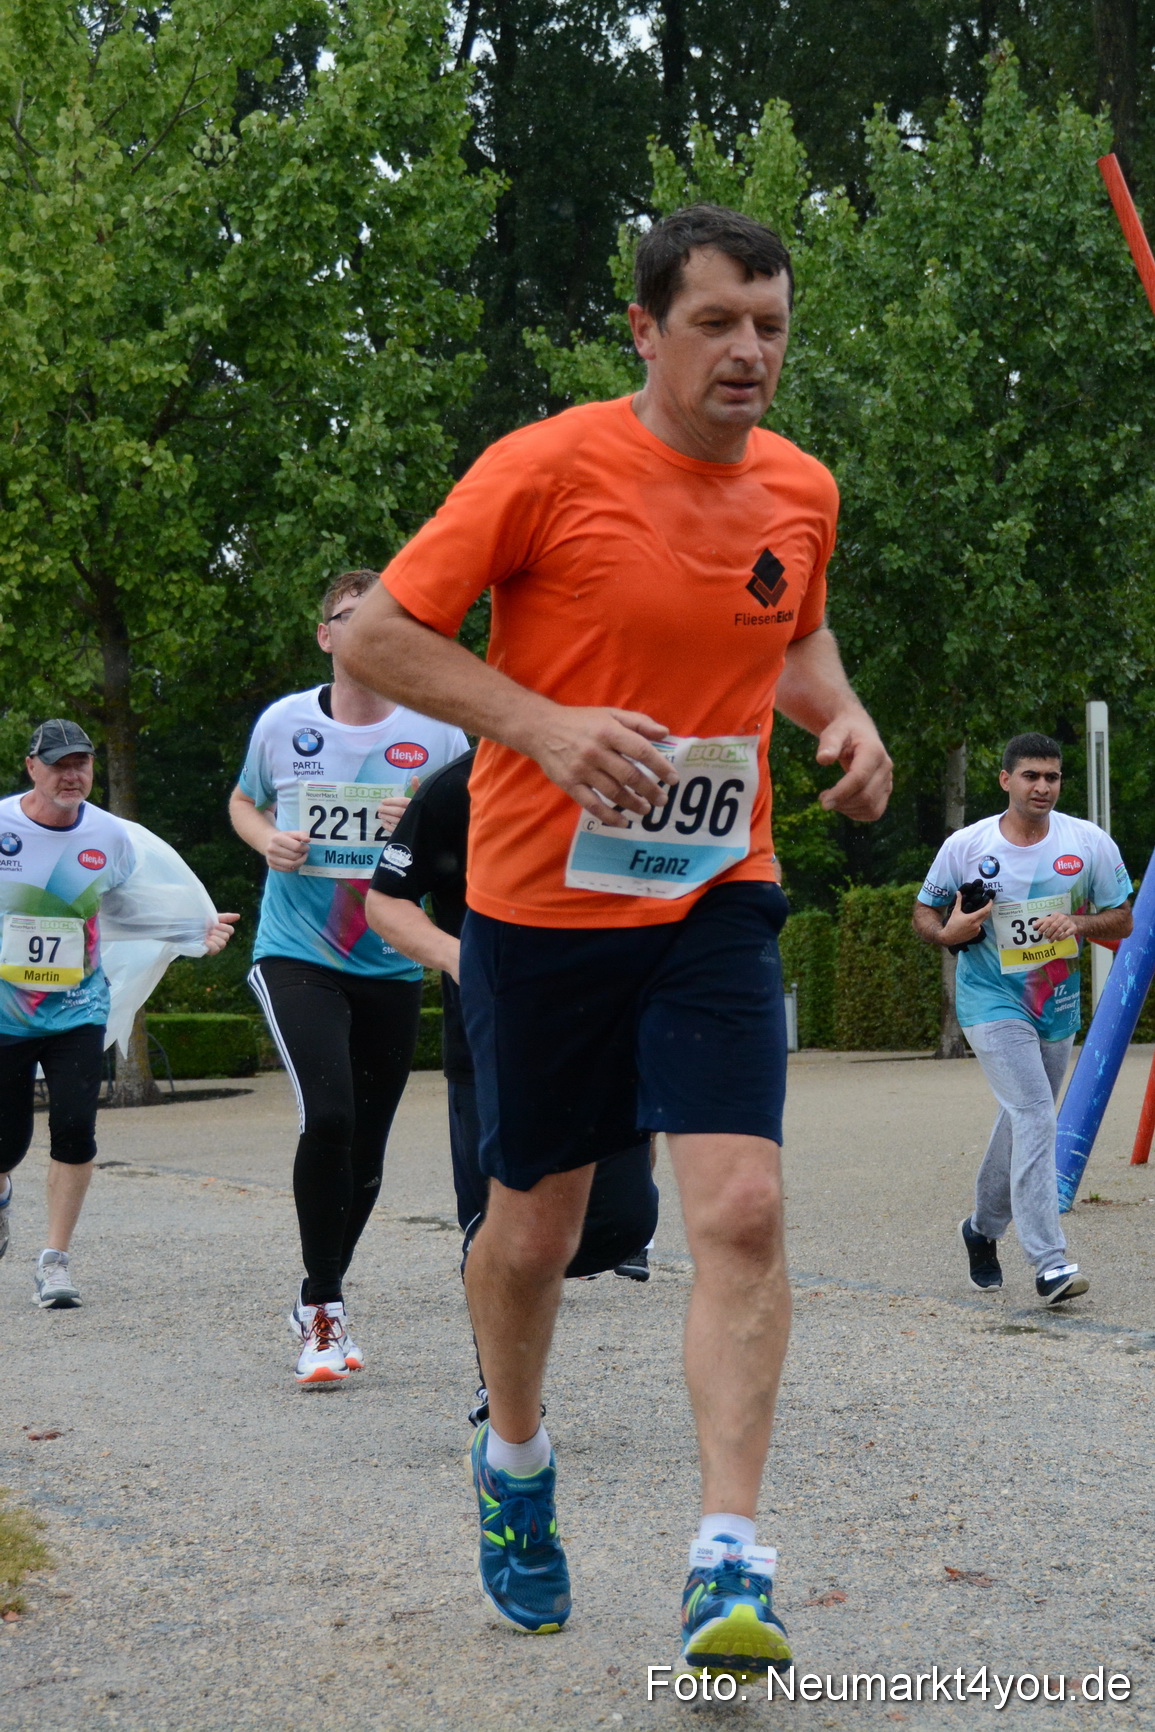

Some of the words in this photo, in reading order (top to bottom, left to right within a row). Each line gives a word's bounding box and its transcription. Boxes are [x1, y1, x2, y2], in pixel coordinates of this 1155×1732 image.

[734, 608, 795, 626] FliesenEichl
[391, 748, 424, 763] Hervis
[686, 743, 749, 763] BOCK
[292, 761, 325, 770] PARTL
[306, 791, 339, 799] NeuerMarkt
[343, 786, 395, 799] BOCK
[82, 853, 105, 865] Hervis
[324, 849, 374, 865] Markus
[629, 849, 690, 876] Franz
[1057, 860, 1081, 870] Hervis
[983, 881, 1003, 889] ARTL
[1026, 898, 1065, 911] BOCK
[39, 919, 79, 931] BOCK
[1010, 914, 1052, 946] 33
[28, 935, 62, 964] 97
[1022, 945, 1057, 962] Ahmad
[24, 969, 60, 982] Martin
[1053, 984, 1068, 998] 17.
